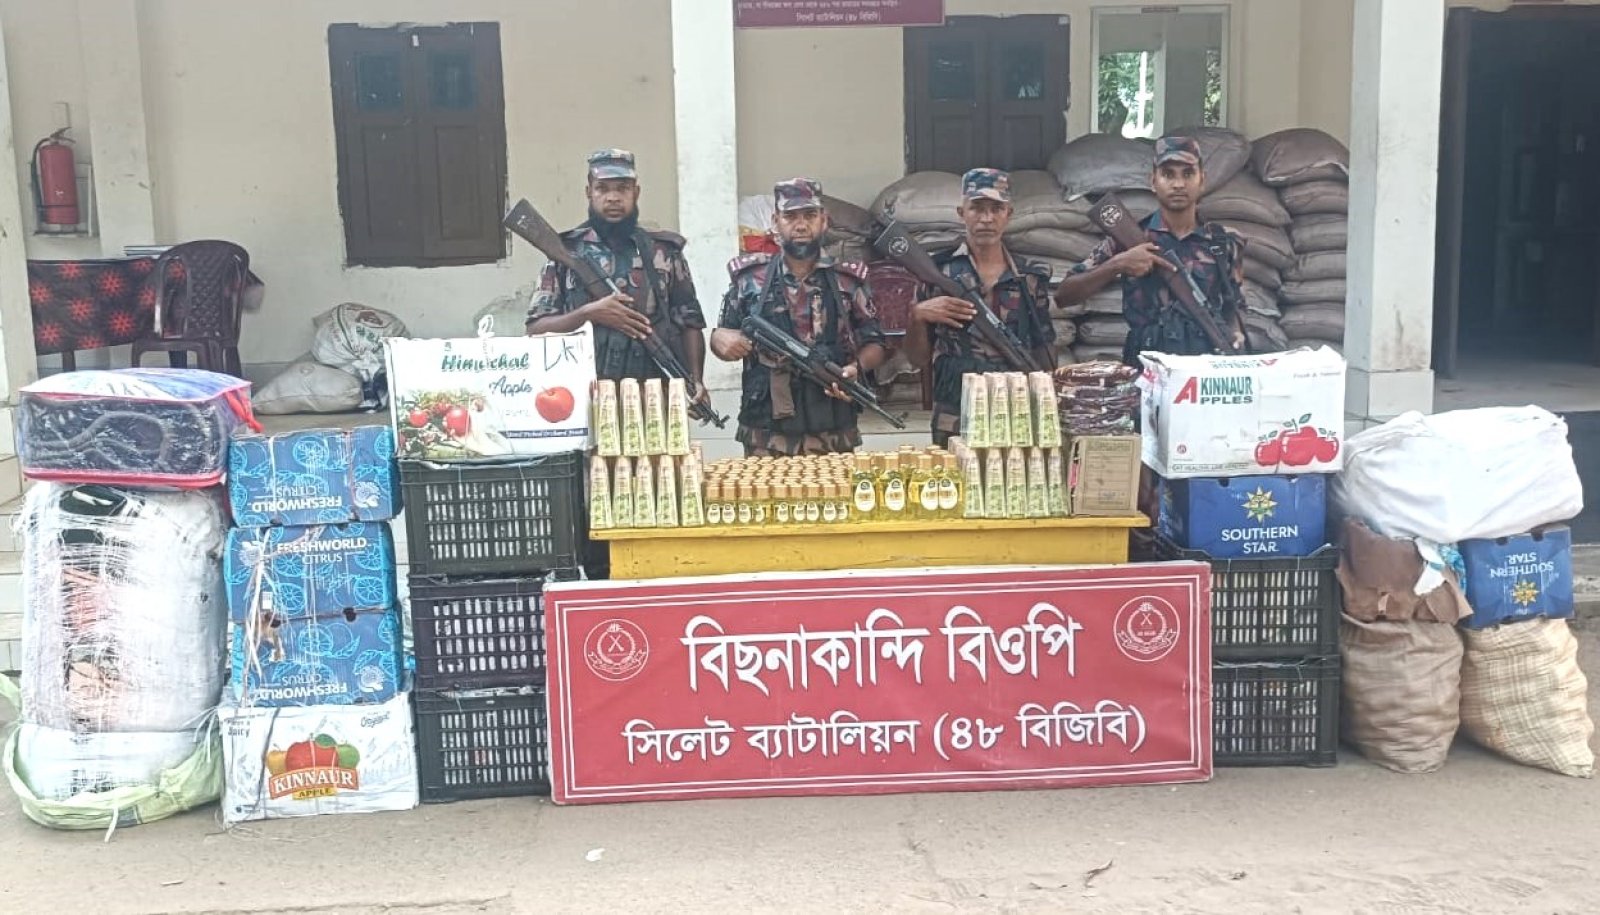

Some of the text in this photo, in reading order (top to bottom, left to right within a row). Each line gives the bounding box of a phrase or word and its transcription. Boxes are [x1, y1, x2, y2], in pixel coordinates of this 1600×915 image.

[489, 375, 533, 396] Apple
[1200, 376, 1254, 395] KINNAUR
[277, 486, 317, 498] CITRUS
[252, 496, 343, 513] FRESHWORLD
[1221, 526, 1299, 541] SOUTHERN
[277, 537, 367, 554] FRESHWORLD
[1243, 542, 1277, 554] STAR
[302, 552, 343, 564] CITRUS
[1508, 552, 1537, 564] STAR
[1490, 561, 1554, 578] SOUTHERN
[680, 602, 1083, 697] বিছনাকান্দি বিওপি
[282, 673, 323, 685] CITRUS
[258, 682, 348, 700] FRESHWORLD
[622, 699, 1146, 765] সিলেট ব্যাটালিয়ন (৪৮ বিজিবি)
[273, 769, 354, 793] KINNAUR
[299, 787, 330, 798] APPLE
